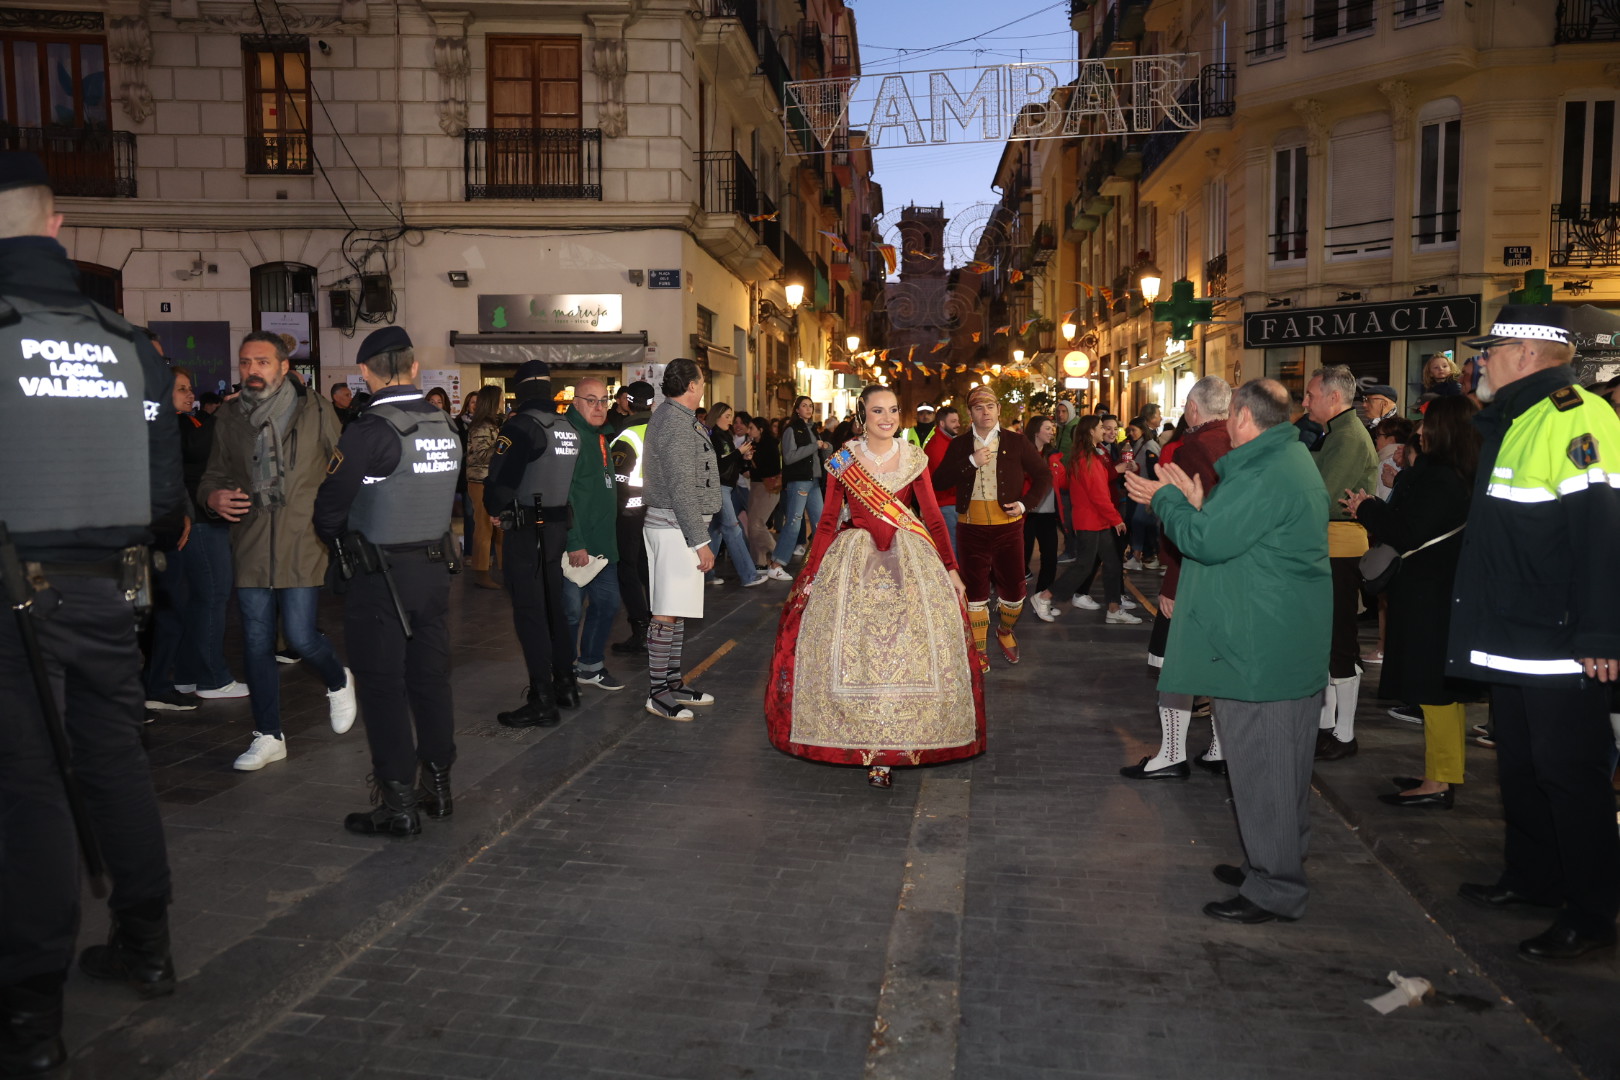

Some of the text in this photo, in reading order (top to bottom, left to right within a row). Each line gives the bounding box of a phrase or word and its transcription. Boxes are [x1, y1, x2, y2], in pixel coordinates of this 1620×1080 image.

[552, 304, 608, 327] maruja
[1261, 305, 1458, 340] FARMACIA
[21, 338, 118, 364] POLICIA
[50, 361, 103, 378] LOCAL
[554, 431, 577, 440] POLICIA
[415, 438, 456, 451] POLICIA
[426, 452, 449, 460] LOCAL
